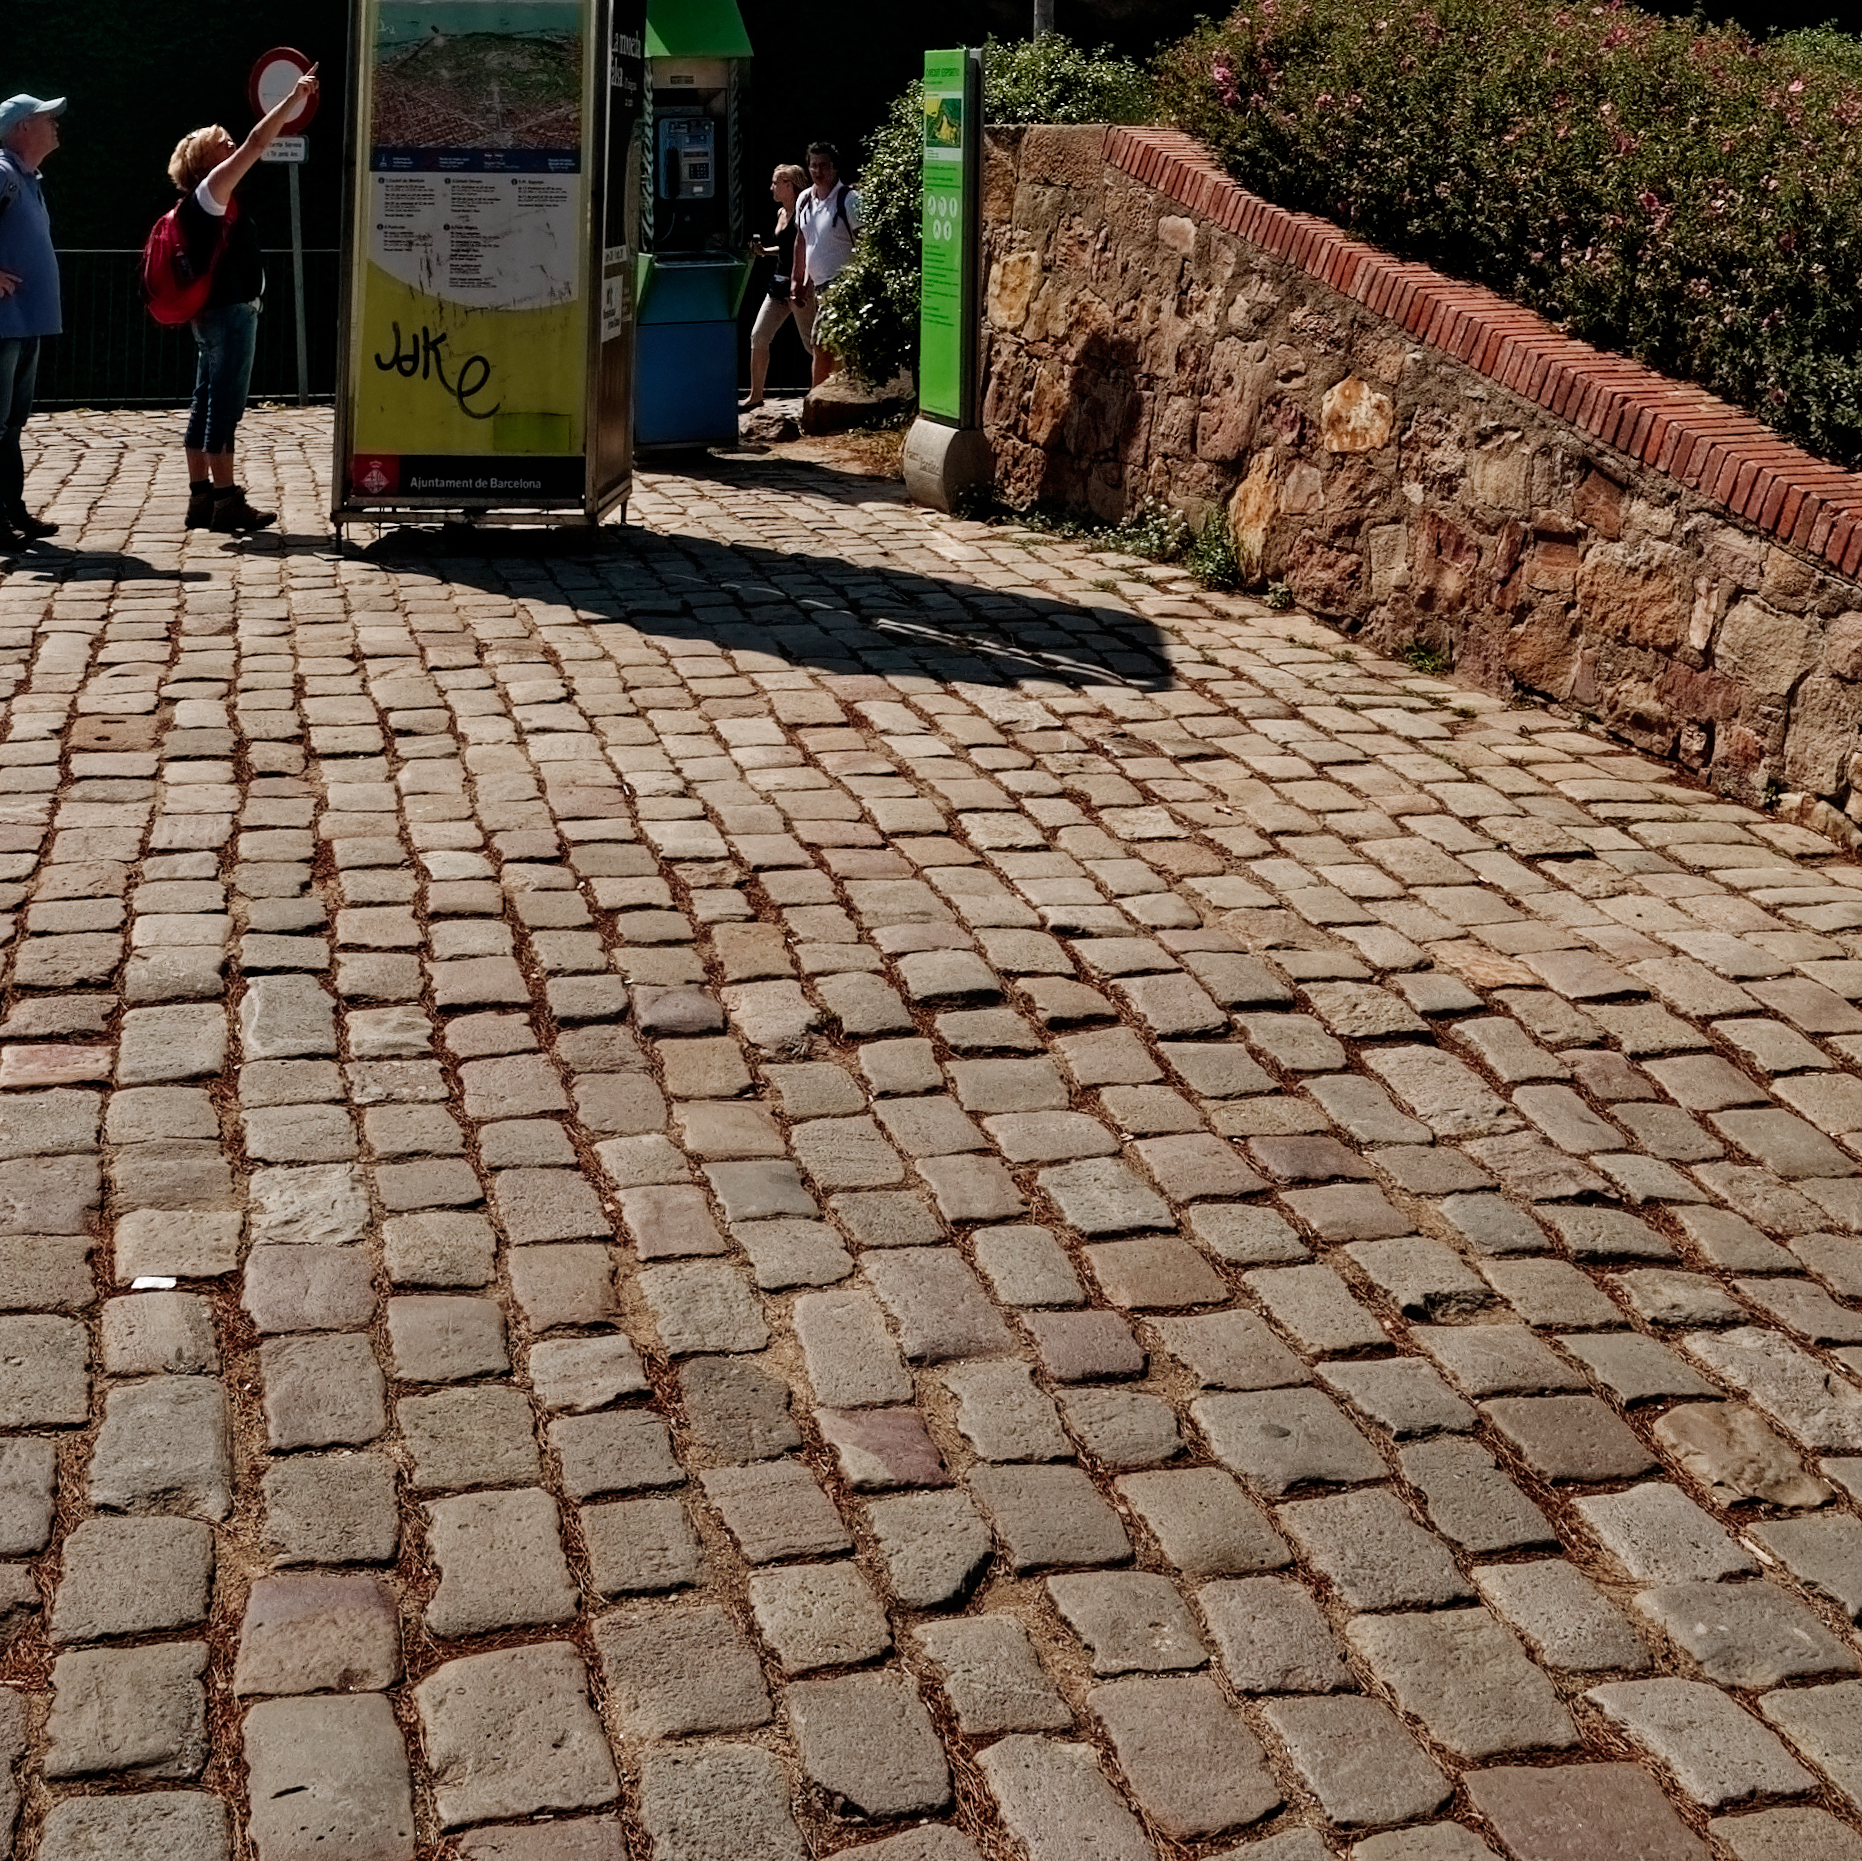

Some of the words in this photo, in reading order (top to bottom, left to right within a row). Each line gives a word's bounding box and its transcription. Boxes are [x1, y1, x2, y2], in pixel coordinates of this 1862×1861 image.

[410, 477, 472, 490] Ajuntament
[475, 477, 488, 489] de
[490, 477, 541, 489] Barcelona
